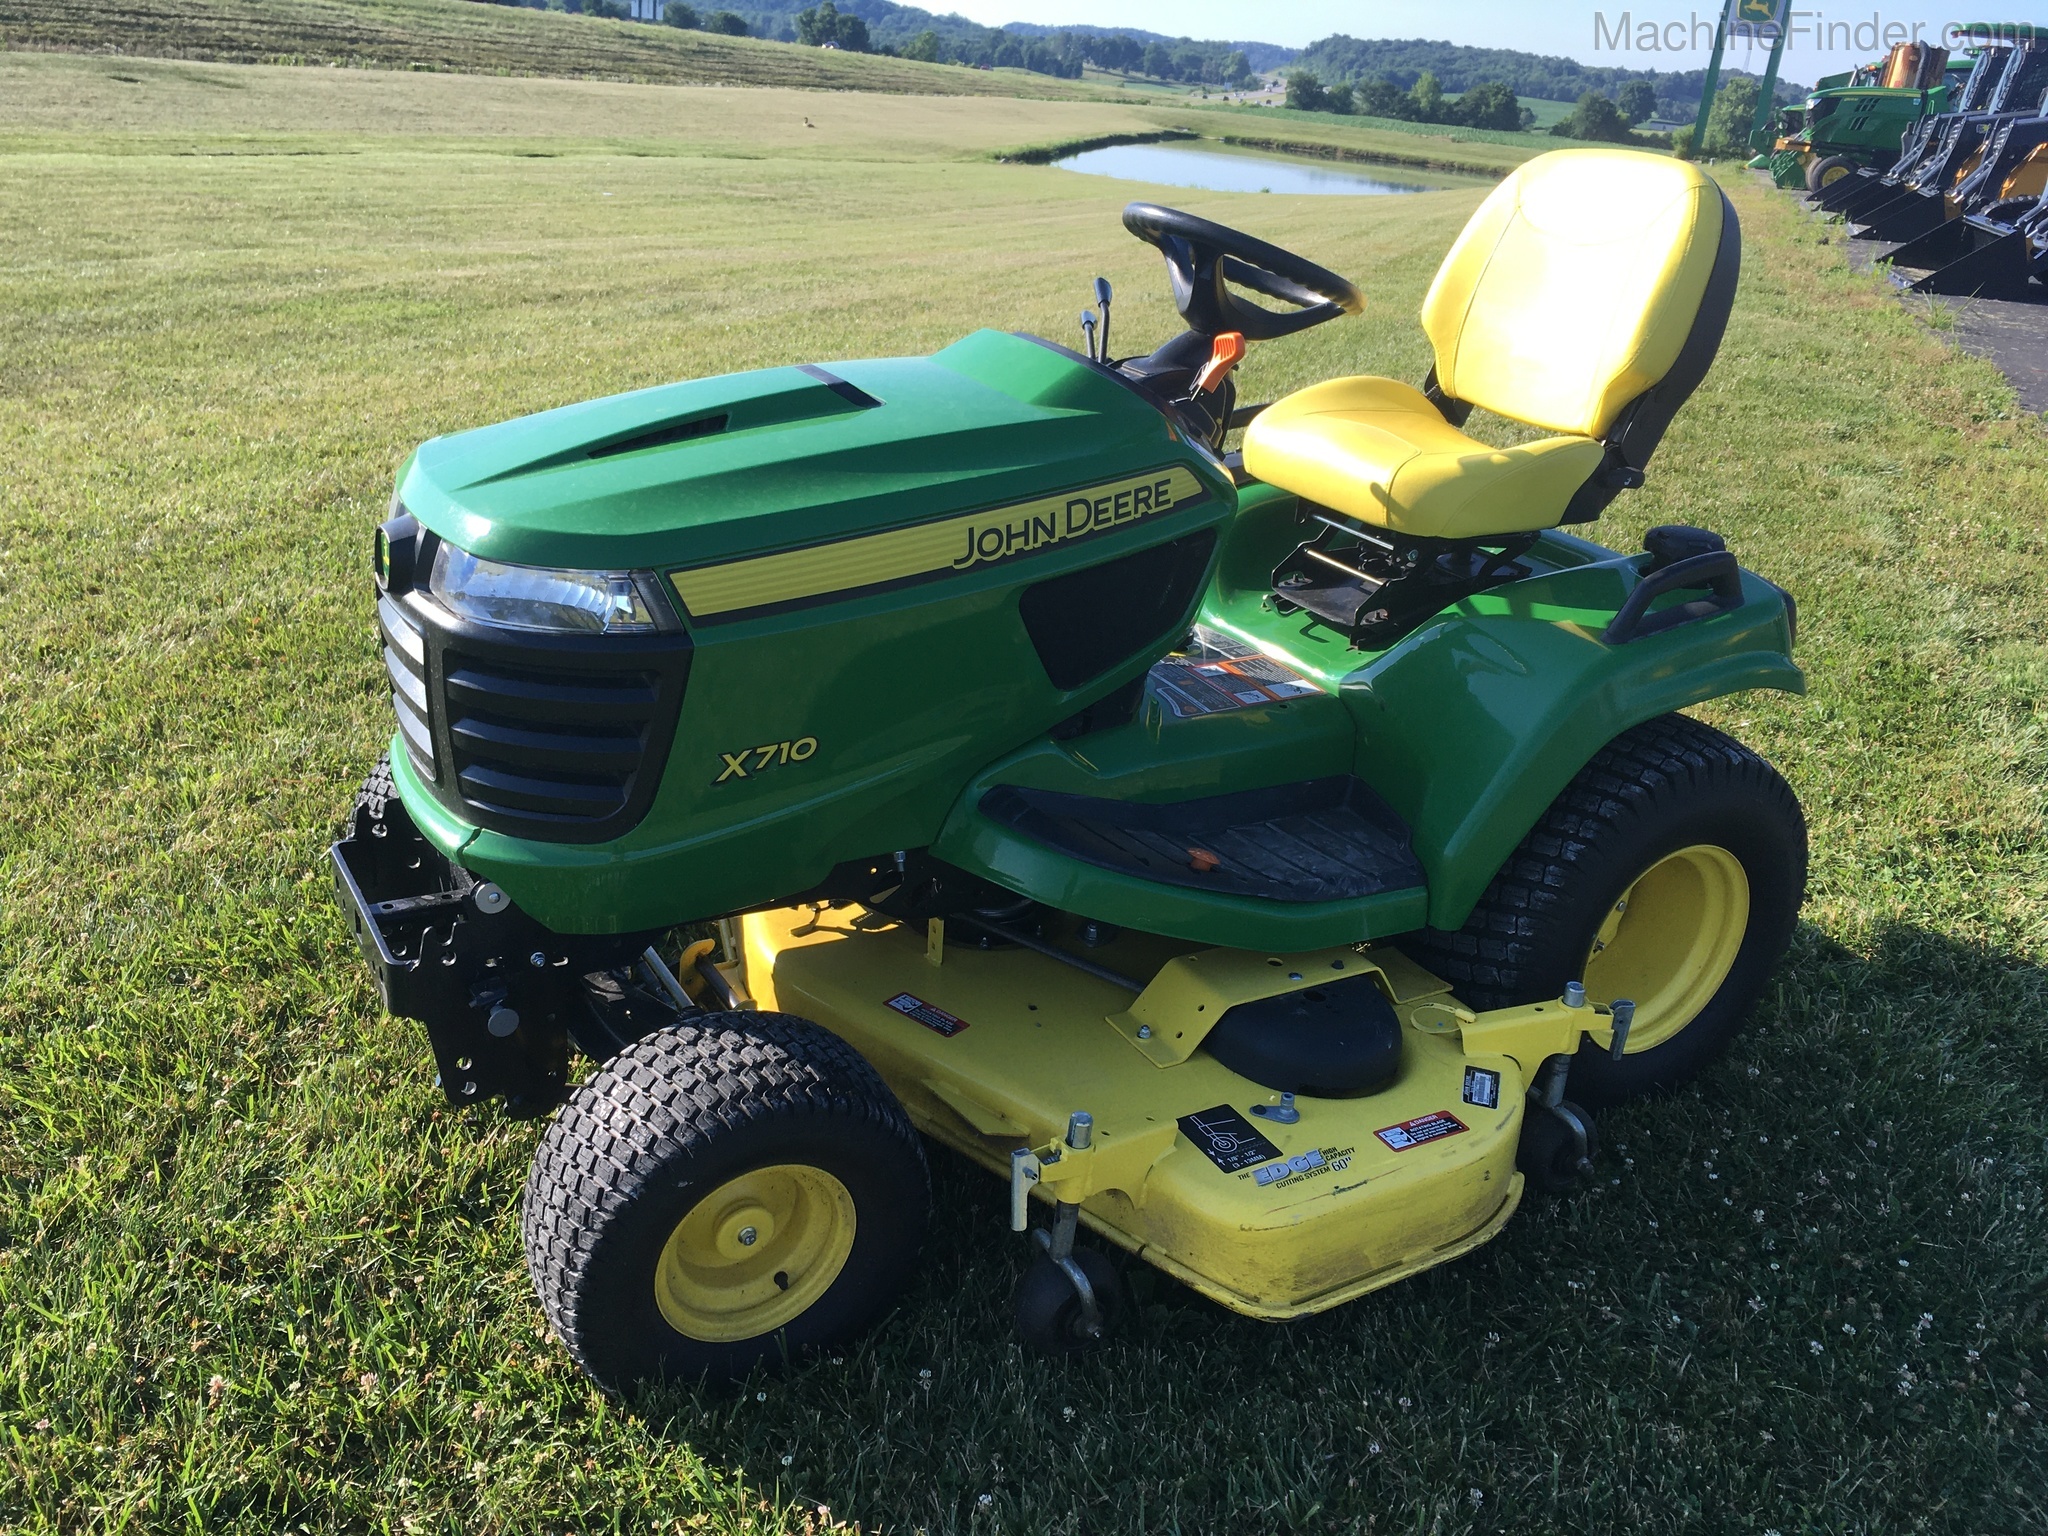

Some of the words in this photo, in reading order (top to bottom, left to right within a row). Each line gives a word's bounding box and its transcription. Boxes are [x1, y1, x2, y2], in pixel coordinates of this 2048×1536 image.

[953, 512, 1056, 567] JOHN
[1066, 478, 1172, 536] DEERE
[715, 737, 818, 783] X710
[1413, 1114, 1438, 1125] DANGER
[1237, 1171, 1251, 1181] THE
[1251, 1148, 1326, 1187] EDGE
[1321, 1146, 1338, 1156] HIGH
[1325, 1147, 1356, 1161] CAPACITY
[1275, 1174, 1305, 1189] CUTTING
[1303, 1165, 1331, 1180] SYSTEM
[1331, 1156, 1352, 1172] 60"
